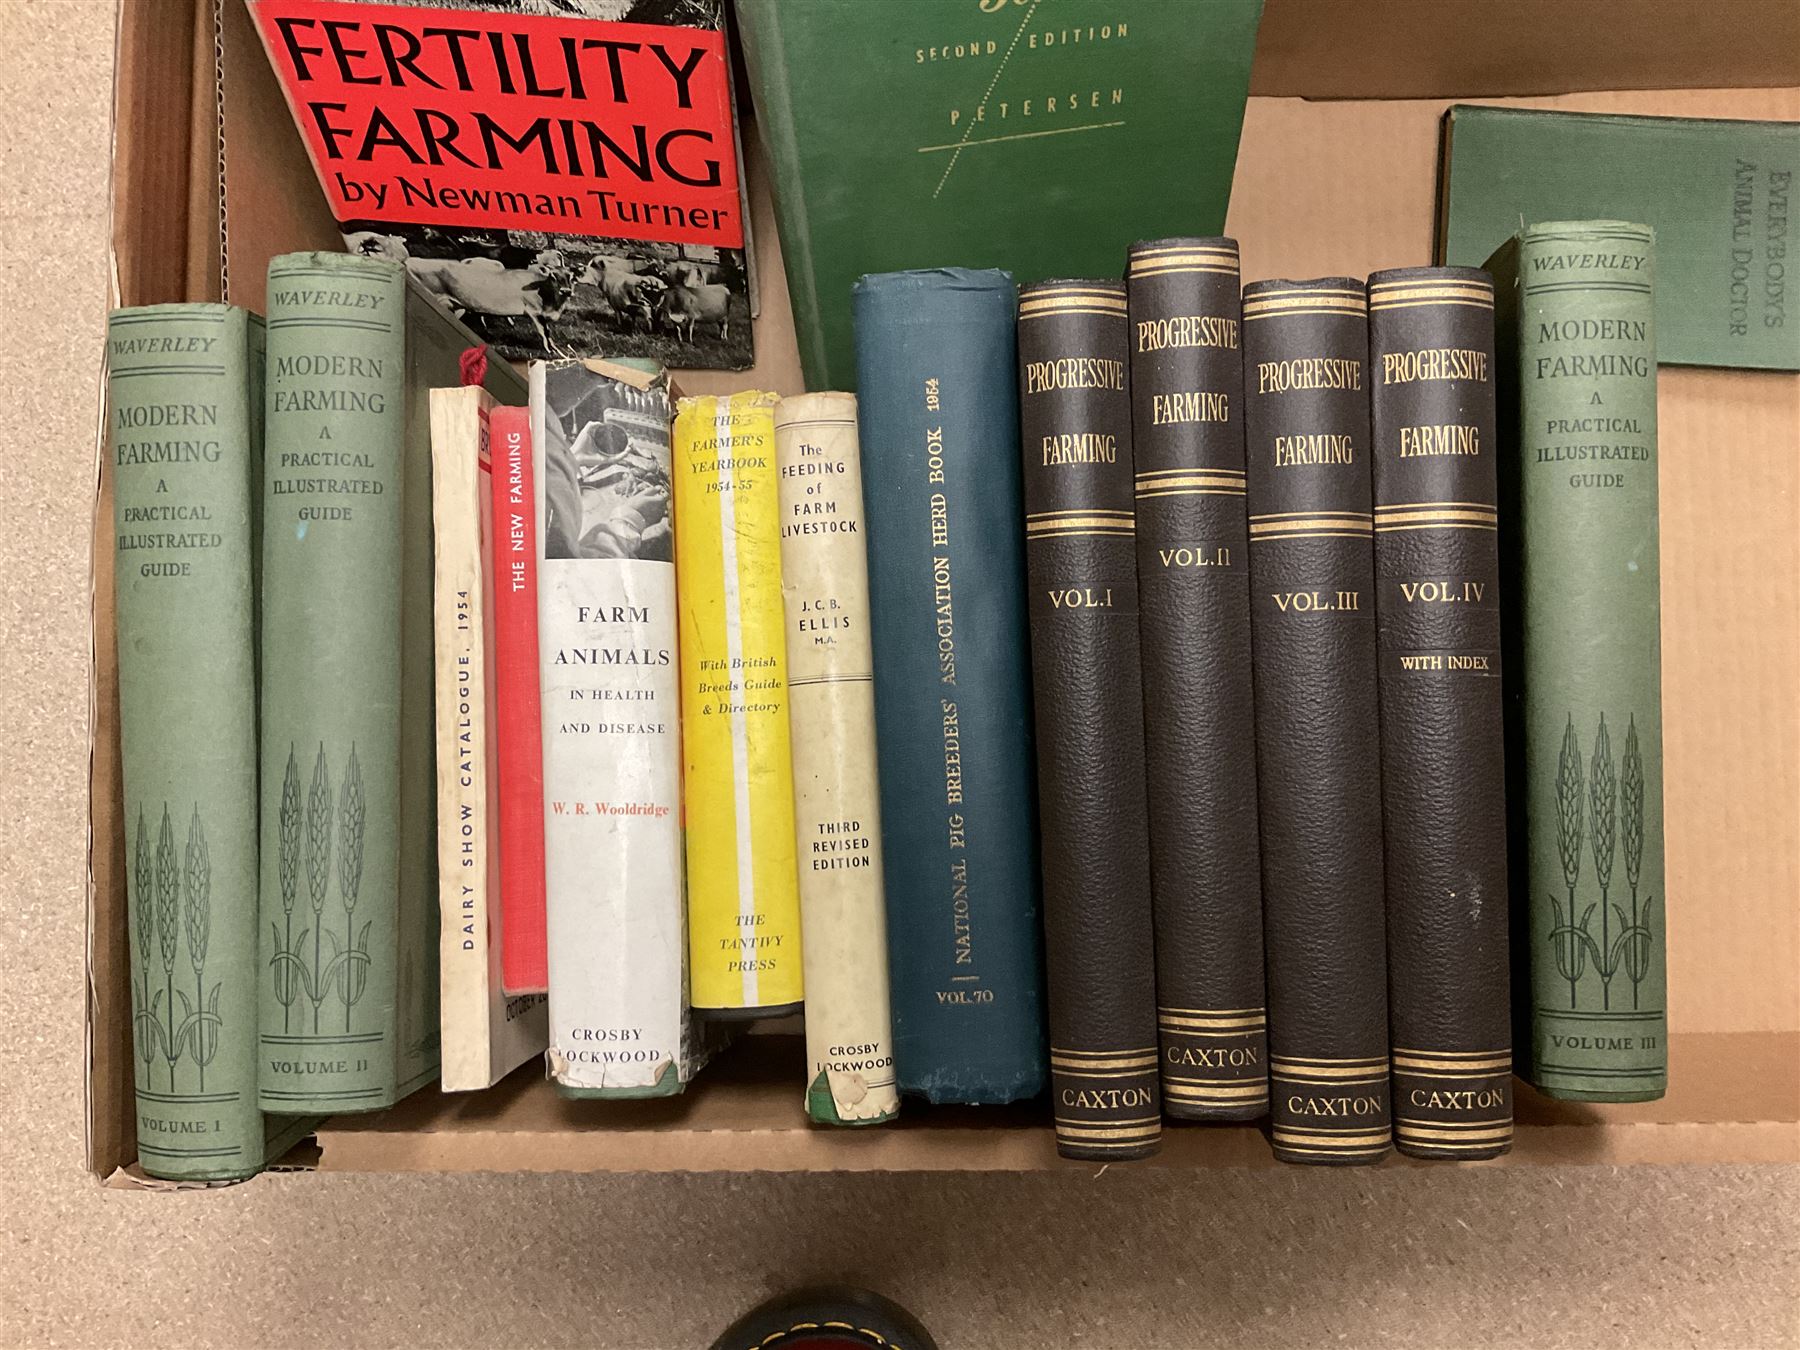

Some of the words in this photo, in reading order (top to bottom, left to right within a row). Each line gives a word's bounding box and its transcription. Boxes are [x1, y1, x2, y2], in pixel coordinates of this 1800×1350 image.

[916, 41, 996, 63] SECOND
[1030, 24, 1127, 48] EDITION
[274, 17, 708, 109] FERTILITY
[951, 89, 1122, 125] PETERSEN
[308, 102, 721, 187] FARMING
[336, 172, 388, 210] by
[396, 176, 581, 219] Newman
[587, 191, 728, 230] Turner
[1733, 158, 1757, 242] ANIMAL
[1533, 254, 1645, 271] WAVERLEY
[275, 292, 383, 309] WAVERLEY
[1730, 249, 1753, 336] DOCTOR
[1138, 317, 1237, 352] PROGRESSIVE
[1538, 319, 1646, 343] MODERN
[114, 338, 216, 354] WAVERLEY
[277, 356, 382, 378] MODERN
[1383, 349, 1486, 384] PROGRESSIVE
[1536, 355, 1648, 378] FARMING
[1027, 358, 1123, 394] PROGRESSIVE
[1258, 359, 1360, 394] PROGRESSIVE
[274, 391, 385, 413] FARMING
[925, 378, 939, 411] 1954
[1590, 392, 1602, 404] A
[118, 405, 216, 429] MODERN
[1153, 393, 1228, 424] FARMING
[712, 415, 740, 427] THE
[1547, 418, 1641, 434] PRACTICAL
[319, 426, 331, 438] A
[693, 435, 764, 452] FARMER'S
[1043, 433, 1116, 466] FARMING
[1400, 426, 1478, 457] FARMING
[117, 441, 221, 465] FARMING
[800, 445, 822, 457] The
[928, 427, 944, 484] BOOK
[1275, 435, 1352, 466] FARMING
[1537, 446, 1648, 462] ILLUSTRATED
[281, 453, 373, 467] PRACTICAL
[508, 433, 522, 503] FARMING
[692, 457, 766, 473] YEARBOOK
[782, 462, 845, 478] FEEDING
[156, 480, 168, 492] A
[273, 480, 382, 495] ILLUSTRATED
[807, 483, 822, 494] of
[1570, 474, 1624, 488] GUIDE
[124, 507, 211, 522] PRACTICAL
[299, 507, 352, 520] GUIDE
[794, 502, 836, 515] FARM
[931, 494, 948, 547] HERD
[511, 514, 524, 550] NEW
[782, 521, 857, 538] LIVESTOCK
[119, 534, 221, 550] ILLUSTRATED
[141, 563, 190, 577] GUIDE
[513, 562, 524, 592] THE
[458, 592, 468, 629] 1954
[577, 607, 649, 623] FARM
[800, 616, 849, 631] ELLIS
[934, 557, 956, 686] ASSOCIATION
[815, 636, 836, 645] M.A.
[555, 649, 669, 665] ANIMALS
[700, 660, 727, 671] With
[732, 657, 776, 669] British
[1401, 656, 1441, 670] WITH
[1448, 656, 1488, 670] INDEX
[699, 683, 738, 693] Breeds
[744, 679, 781, 690] Guide
[570, 690, 583, 699] IN
[592, 690, 654, 700] HEALTH
[703, 705, 711, 715] &
[719, 702, 780, 714] Directory
[560, 723, 590, 733] AND
[599, 724, 665, 733] DISEASE
[941, 699, 962, 804] BREEDERS'
[552, 802, 569, 815] W.
[575, 802, 589, 815] R.
[596, 802, 669, 816] Wooldridge
[462, 805, 472, 866] SHOW
[818, 821, 859, 834] THIRD
[949, 813, 964, 848] PIG
[813, 838, 868, 852] REVISED
[813, 856, 869, 870] EDITION
[463, 886, 474, 949] DAIRY
[735, 914, 765, 926] THE
[952, 859, 972, 964] NATIONAL
[720, 936, 783, 950] TANTIVY
[728, 959, 776, 972] PRESS
[572, 1029, 642, 1041] CROSBY
[1553, 1035, 1633, 1050] VOLUME
[1641, 1036, 1656, 1049] III
[830, 1043, 879, 1056] CROSBY
[1168, 1047, 1257, 1067] CAXTON
[271, 1061, 347, 1073] VOLUME
[356, 1060, 367, 1071] II
[1062, 1088, 1151, 1108] CAXTON
[1289, 1096, 1381, 1116] CAXTON
[1411, 1089, 1503, 1110] CAXTON
[141, 1117, 206, 1133] VOLUME
[215, 1121, 220, 1132] I
